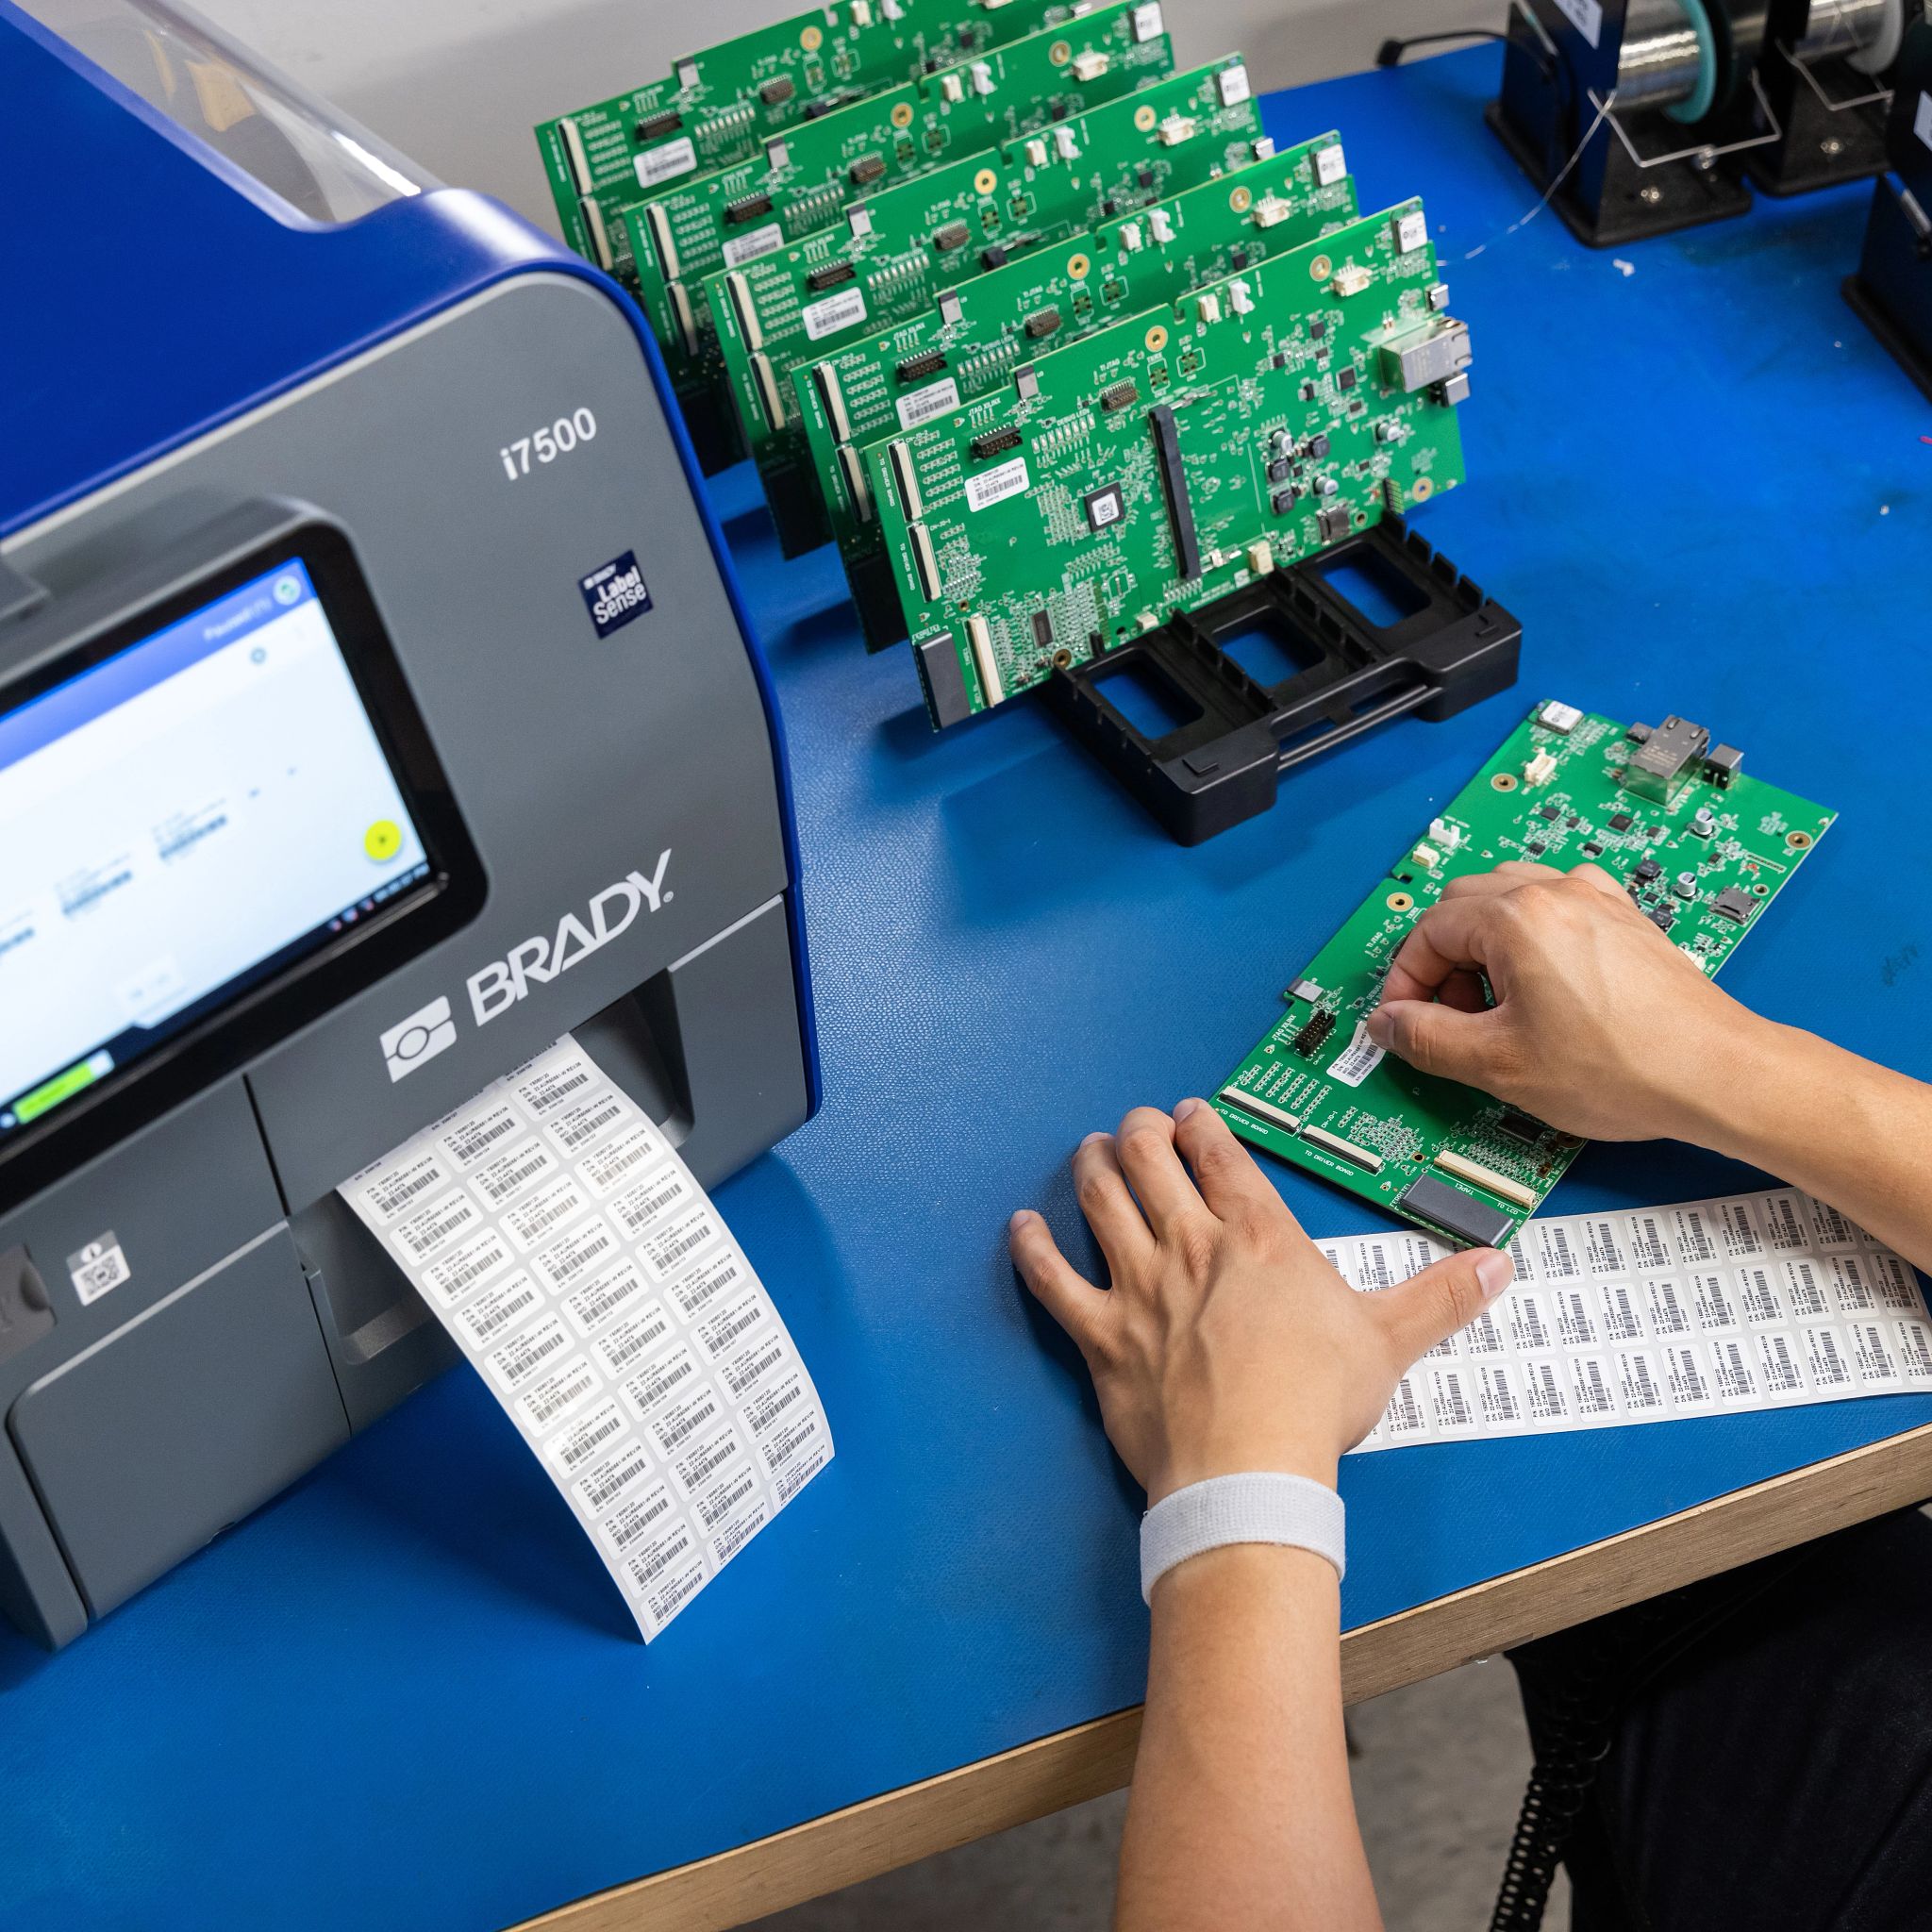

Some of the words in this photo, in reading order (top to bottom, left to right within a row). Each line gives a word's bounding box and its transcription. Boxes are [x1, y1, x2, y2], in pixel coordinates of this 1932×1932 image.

[968, 405, 983, 416] JTAG
[500, 407, 597, 481] i7500
[597, 565, 641, 603] Label
[593, 583, 646, 624] Sense
[466, 848, 672, 1027] BRADY
[1371, 932, 1383, 944] JTAG
[1367, 986, 1380, 1000] DEBUG
[1272, 1028, 1284, 1041] JTAG
[1229, 1113, 1249, 1125] DRIVER
[1251, 1124, 1268, 1134] BOARD
[1314, 1154, 1334, 1166] DRIVER
[1335, 1165, 1354, 1176] BOARD
